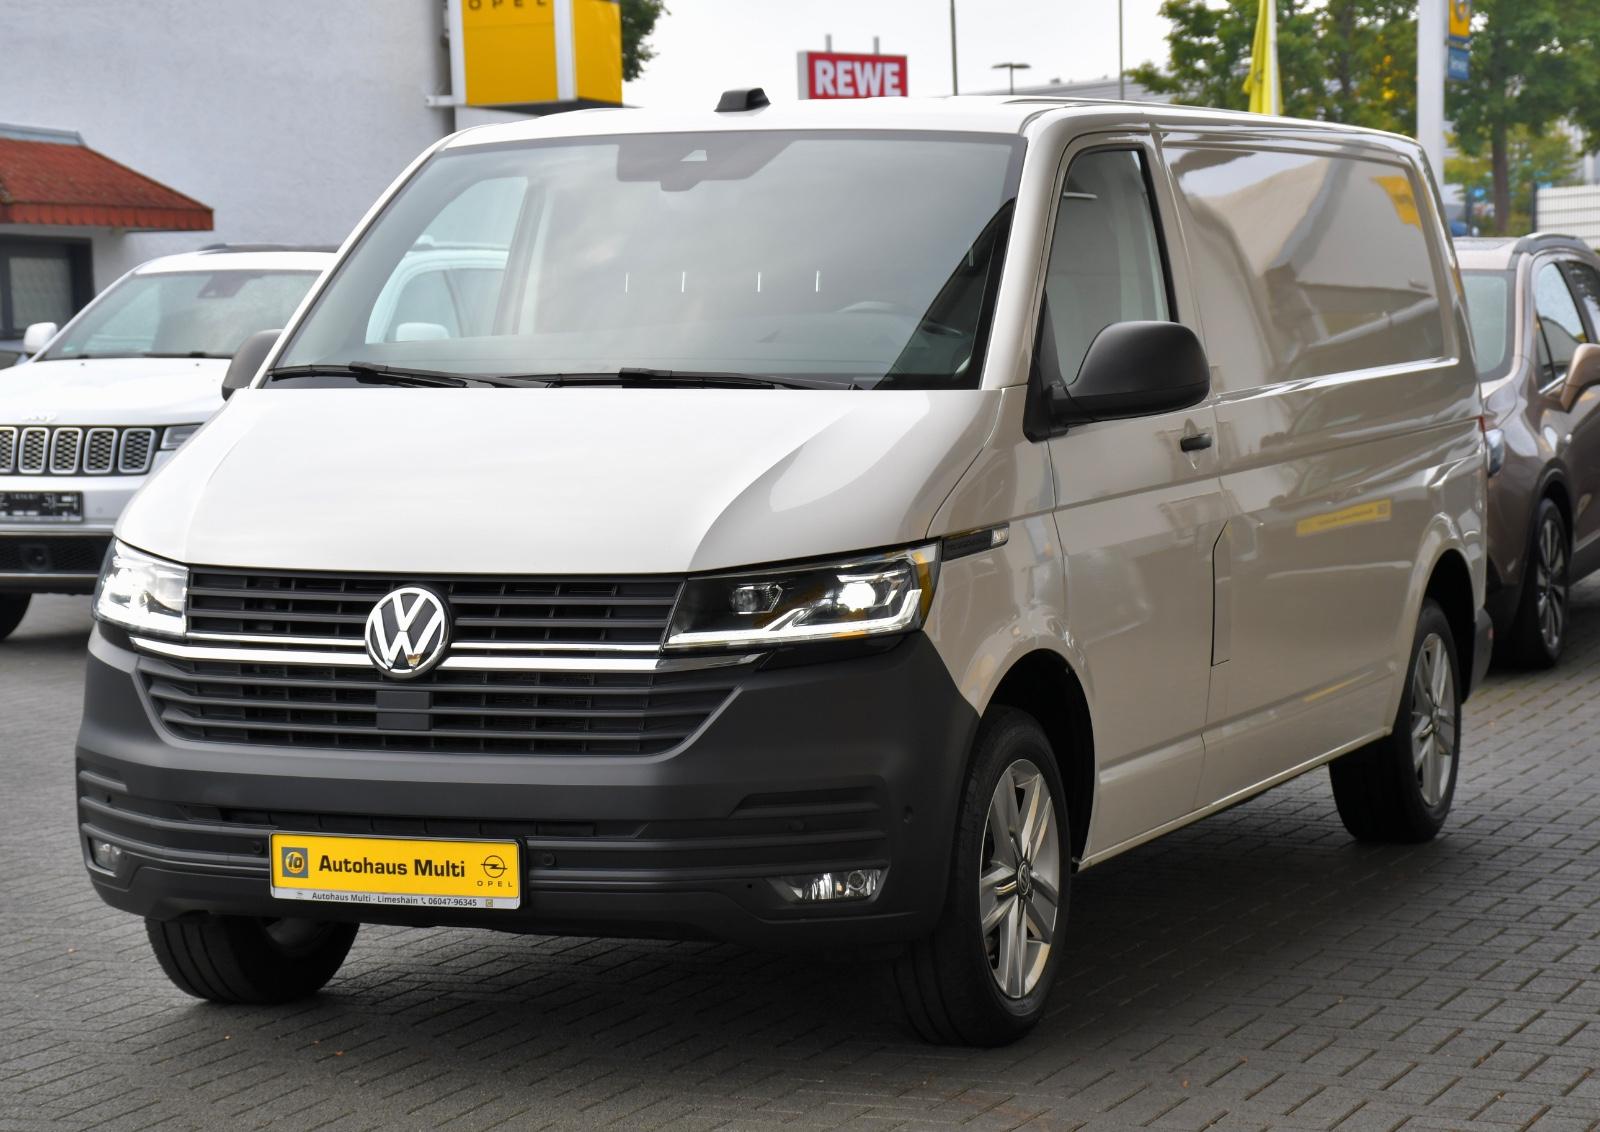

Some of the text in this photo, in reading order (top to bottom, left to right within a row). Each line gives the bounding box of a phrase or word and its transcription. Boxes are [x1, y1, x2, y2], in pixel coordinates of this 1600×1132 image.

[815, 60, 902, 97] REWE
[367, 590, 445, 672] VW
[319, 855, 465, 878] Autohaus Multi
[477, 880, 513, 888] OPEL
[311, 892, 349, 902] Autohaus
[350, 894, 371, 903] Multi
[377, 895, 418, 905] Limeshain
[428, 897, 477, 907] 06047-96345
